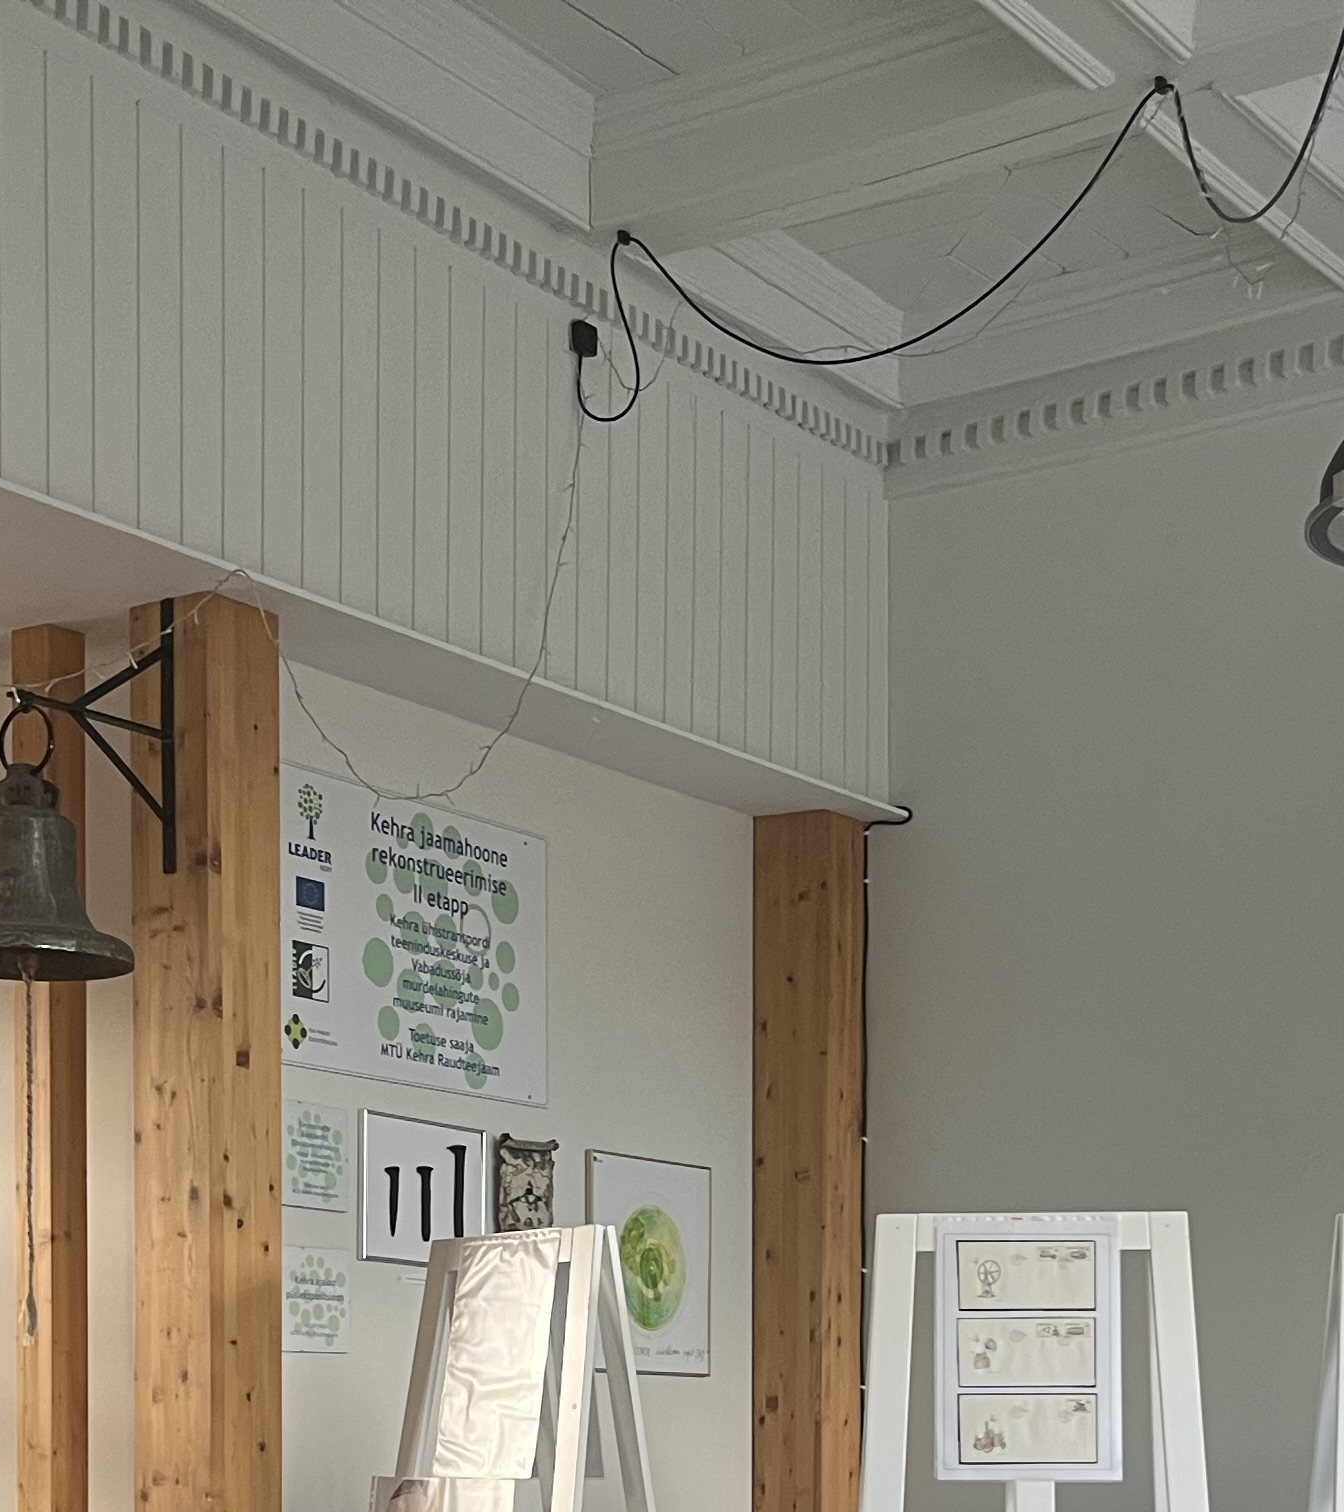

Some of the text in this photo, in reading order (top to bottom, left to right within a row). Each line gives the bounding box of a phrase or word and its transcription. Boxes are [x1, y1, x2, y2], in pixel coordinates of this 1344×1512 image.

[288, 842, 332, 865] LEADER
[371, 811, 508, 868] Kehra jaamahoone
[371, 846, 507, 896] rekonstrueerimise
[427, 891, 469, 920] etapp
[390, 912, 419, 933] Kehra
[391, 935, 490, 971] teeninduskeskuse ja
[402, 979, 480, 1005] murdelahingute
[446, 1005, 489, 1026] rajamine
[408, 1027, 475, 1055] Toetuse saaja
[380, 1042, 501, 1078] MTÜ Kehra Raudteejaam
